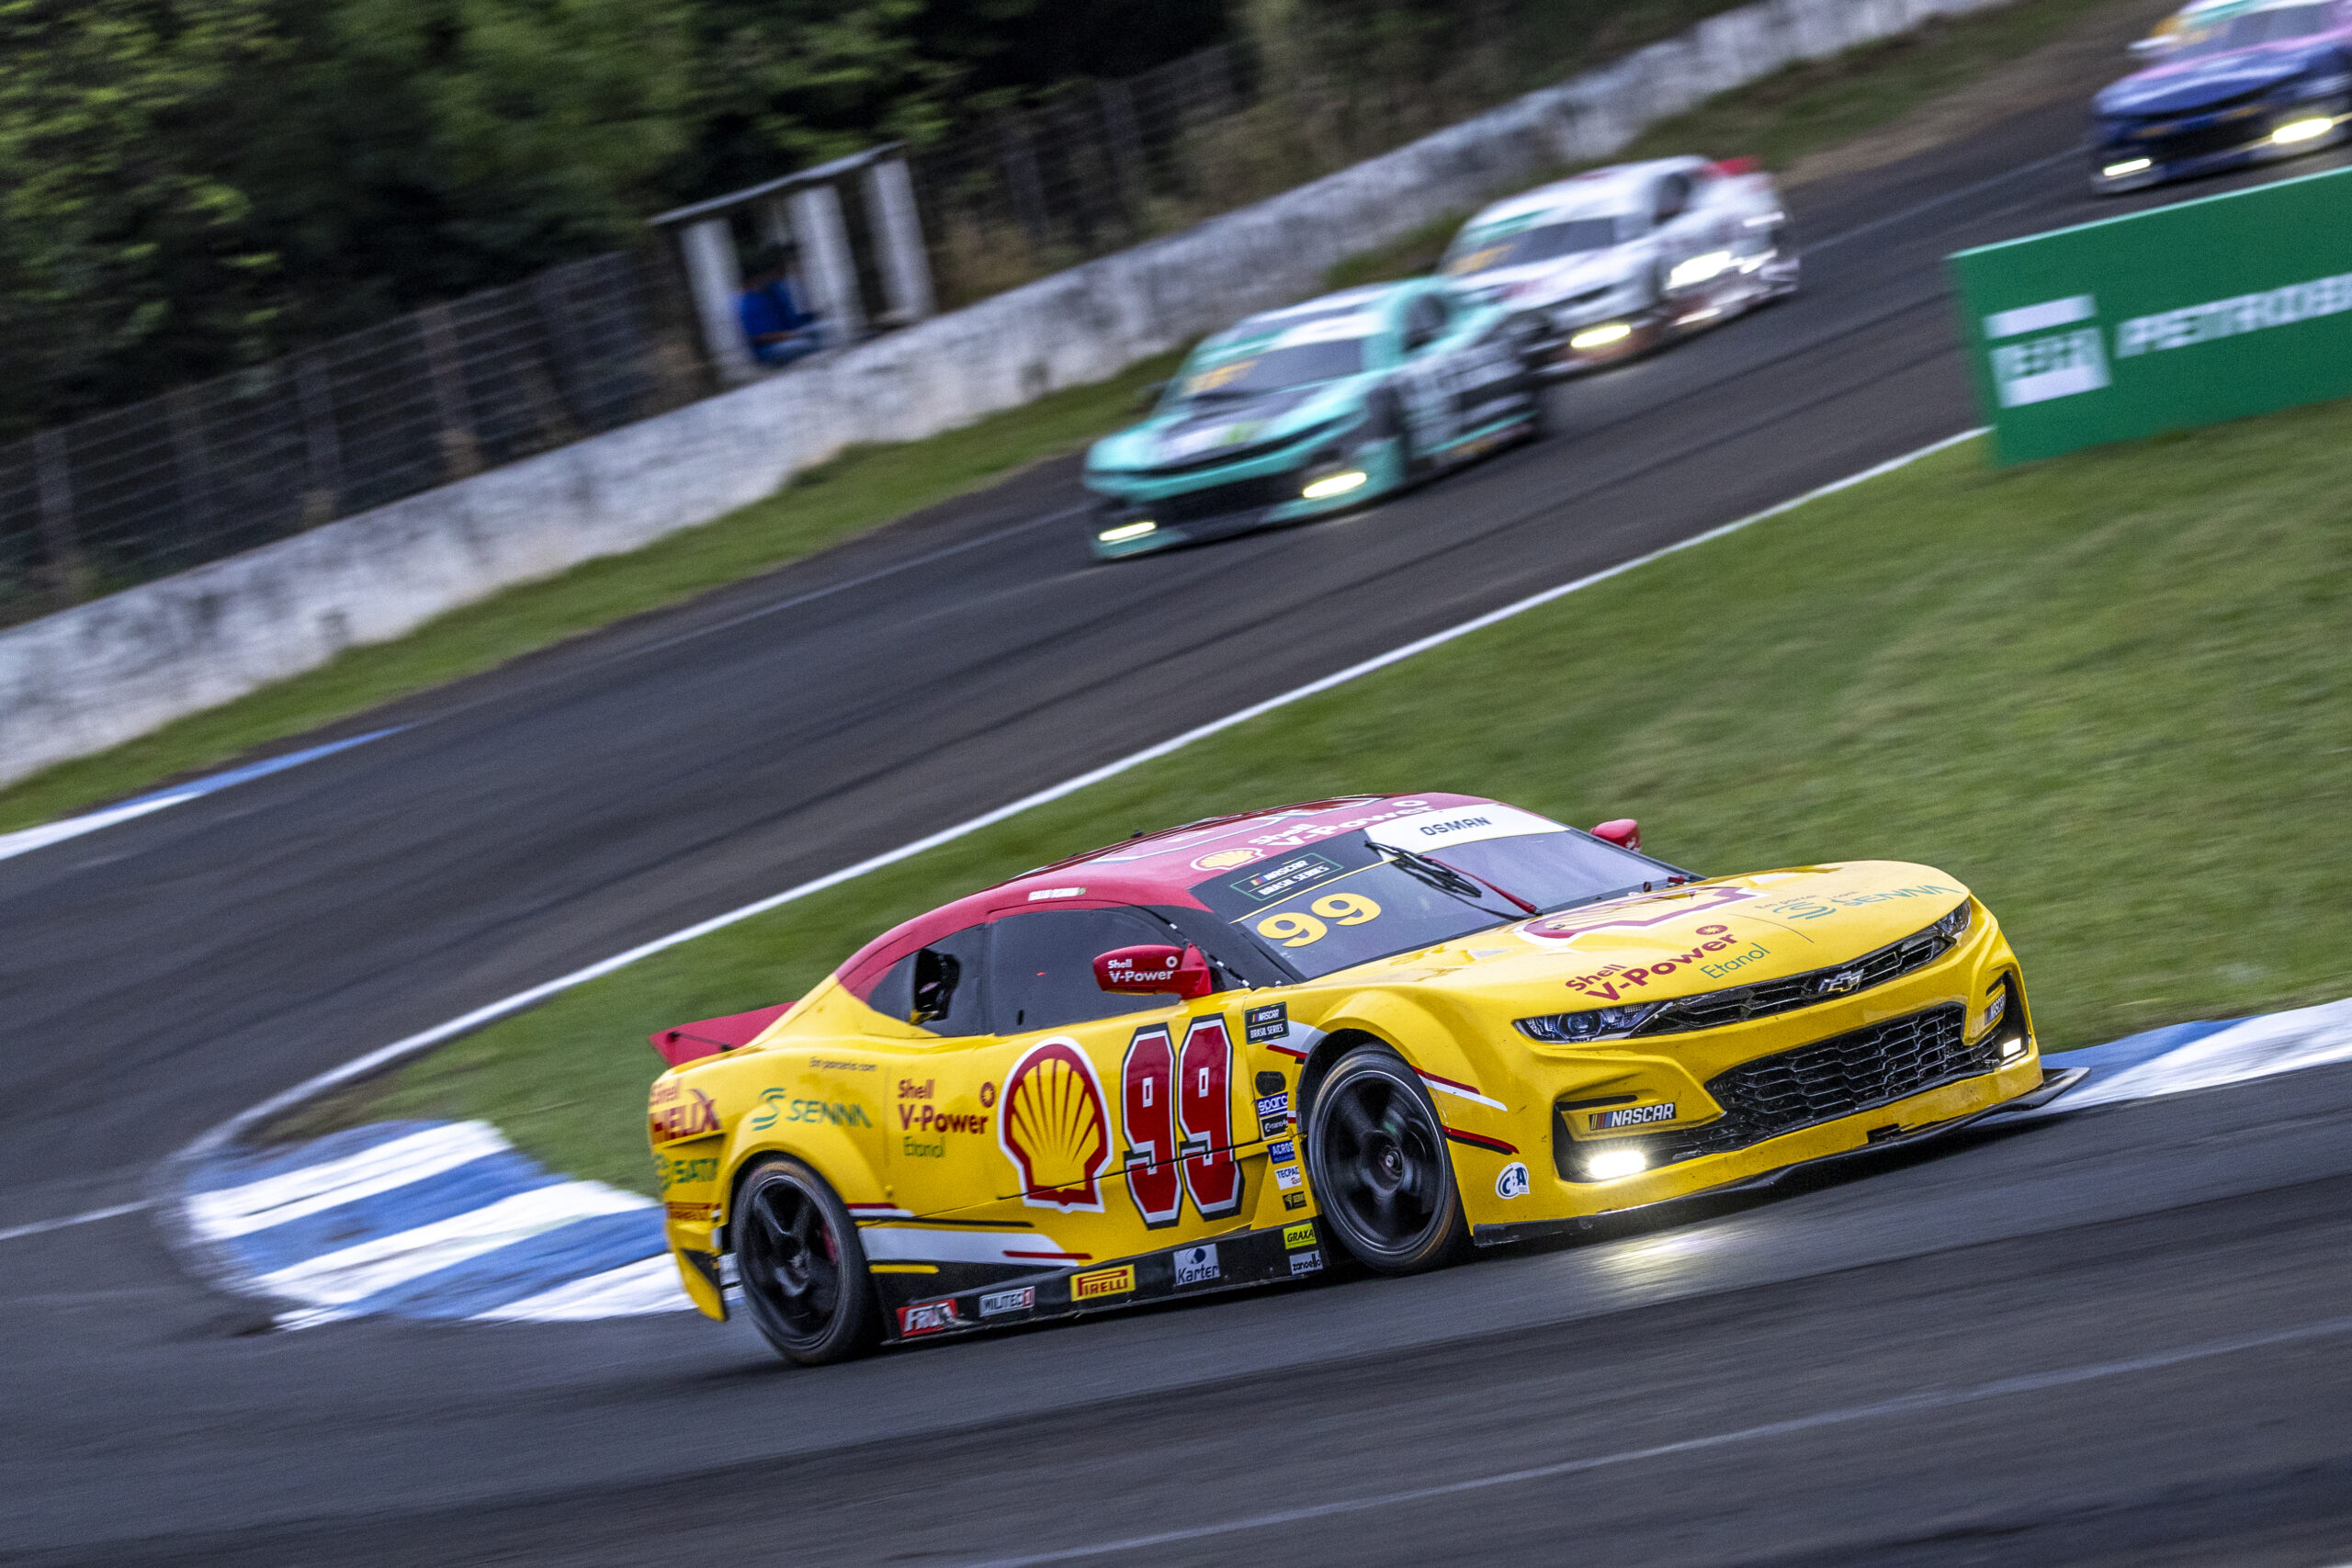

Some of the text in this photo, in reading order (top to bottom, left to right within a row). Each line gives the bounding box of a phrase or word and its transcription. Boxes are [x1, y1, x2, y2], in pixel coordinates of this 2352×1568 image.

[1249, 823, 1317, 844] Shell
[1419, 817, 1492, 836] OSMAN
[1263, 860, 1309, 881] NASCAR
[1257, 892, 1382, 948] 99
[1108, 958, 1132, 969] Shell
[1585, 933, 1737, 1001] V-Power
[1700, 942, 1770, 979] Etanol
[1109, 970, 1174, 983] V-Power
[1565, 964, 1627, 991] Shell
[1259, 1009, 1279, 1021] NASCAR
[898, 1077, 935, 1100] Shell
[786, 1099, 873, 1128] SENNA
[898, 1104, 989, 1134] V-Power
[1122, 1011, 1245, 1231] 99
[1611, 1103, 1674, 1127] NASCAR
[1077, 1269, 1128, 1297] PIRELLI
[1177, 1264, 1218, 1284] Karter
